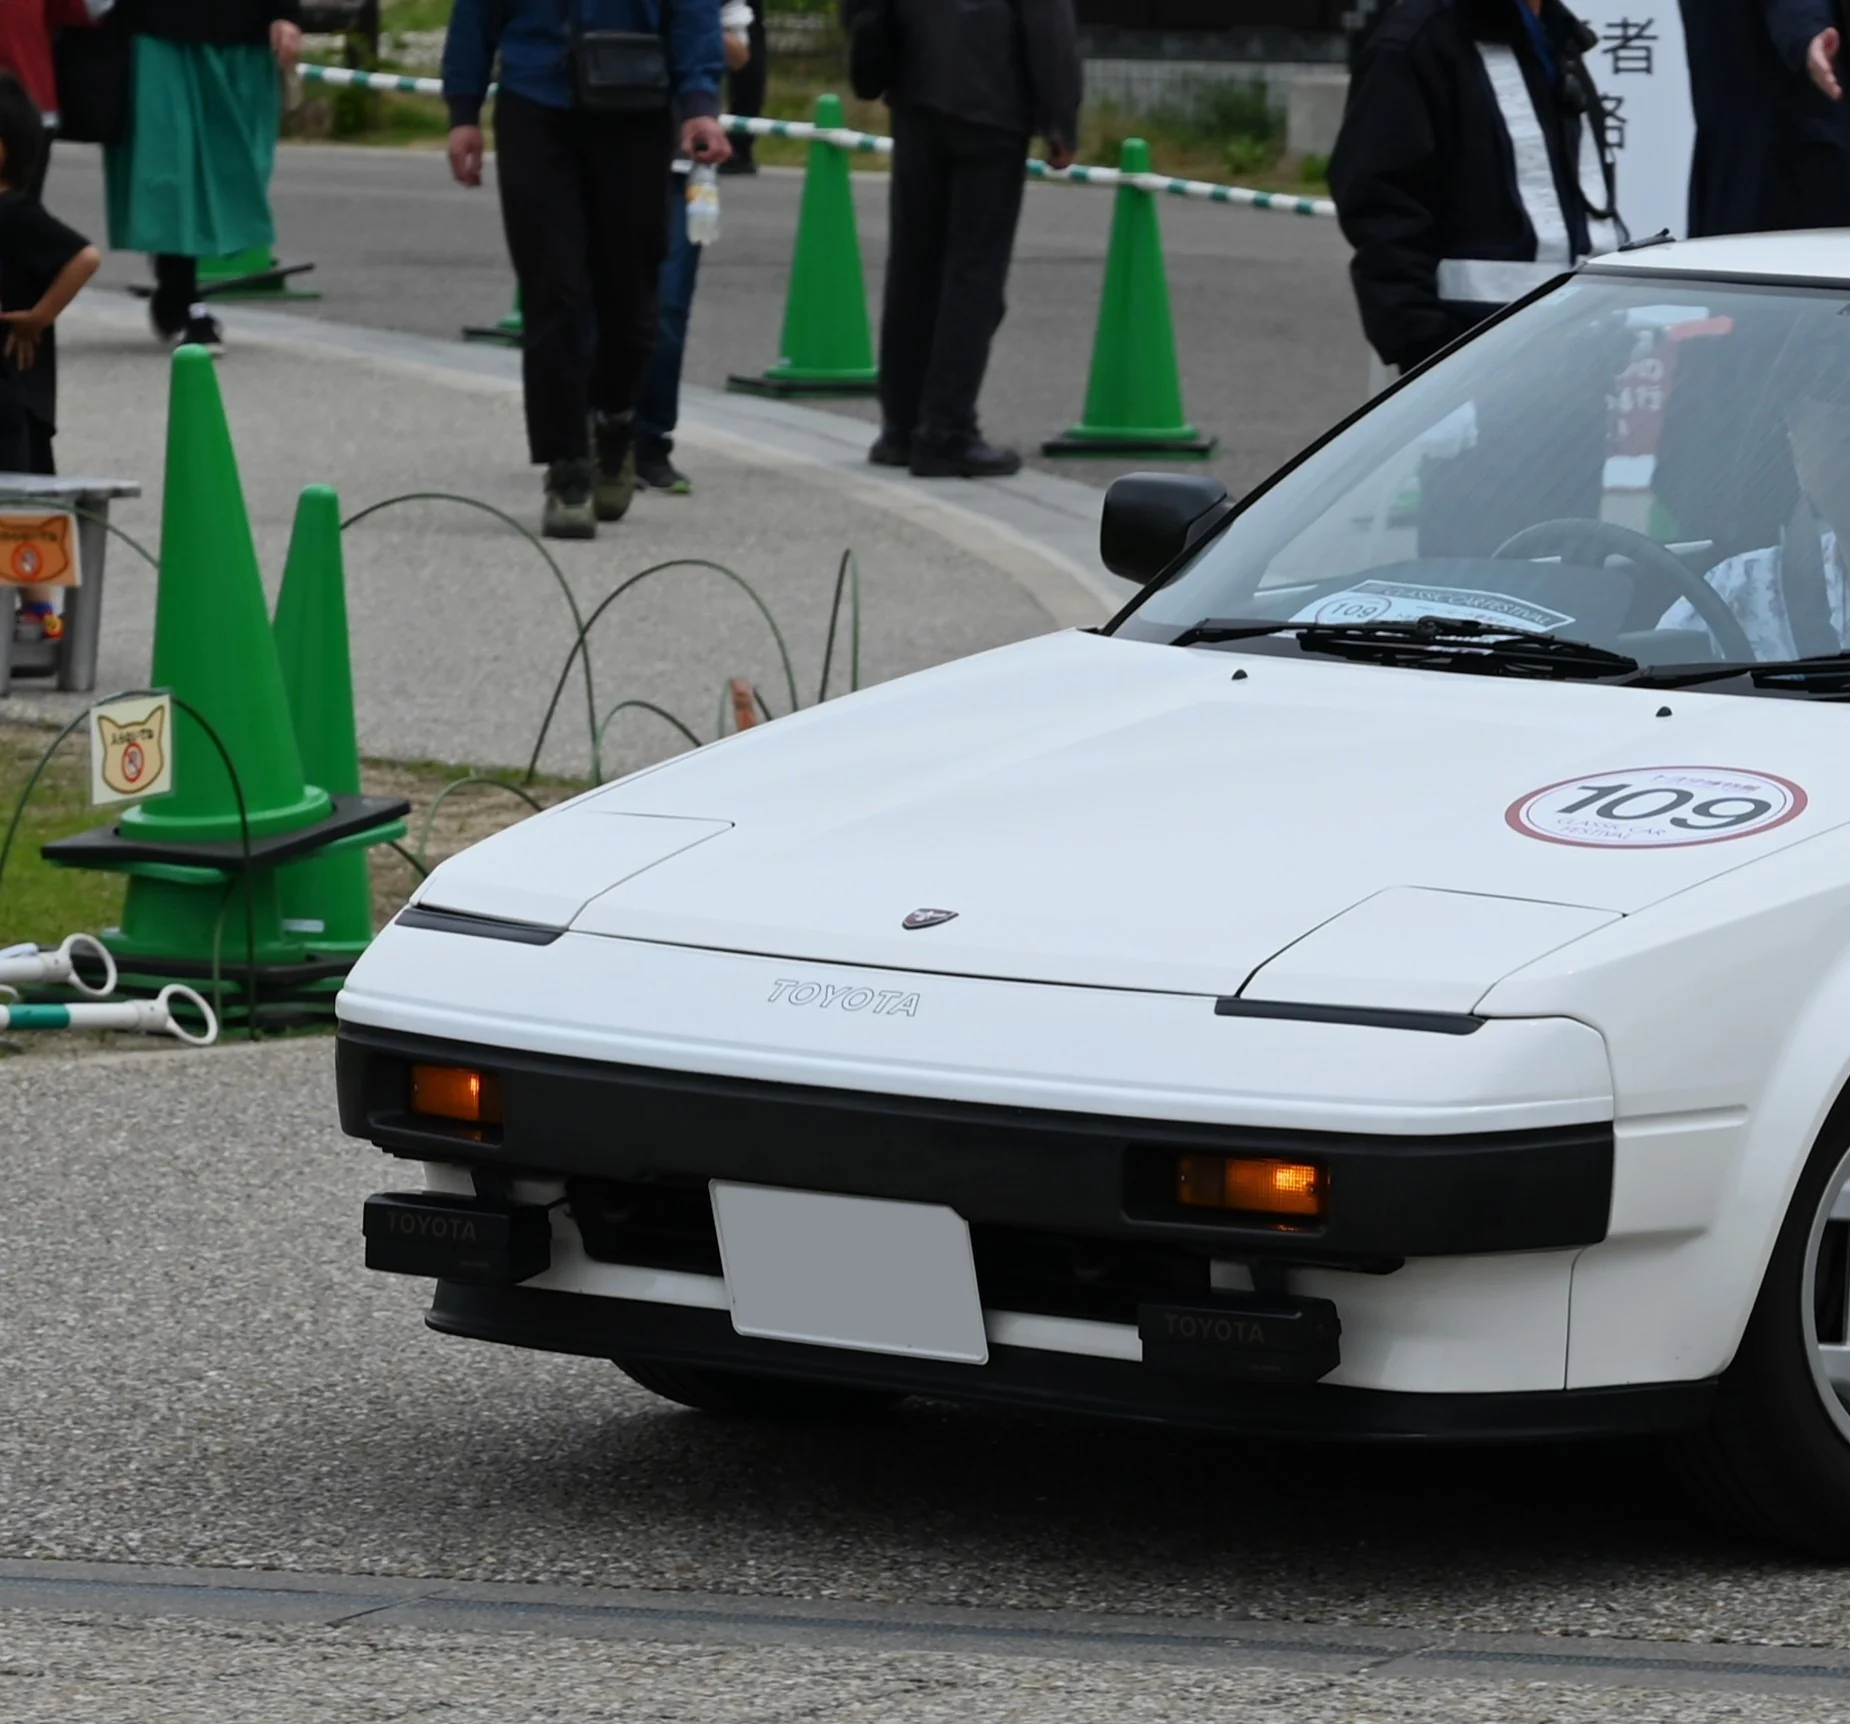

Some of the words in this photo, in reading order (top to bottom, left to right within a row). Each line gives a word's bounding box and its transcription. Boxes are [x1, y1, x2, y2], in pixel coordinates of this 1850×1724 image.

[1331, 600, 1379, 620] 109
[1555, 783, 1773, 830] 109
[768, 978, 921, 1018] TOYOTA
[386, 1211, 477, 1241] TOYOTA
[1164, 1312, 1265, 1344] TOYOTA
